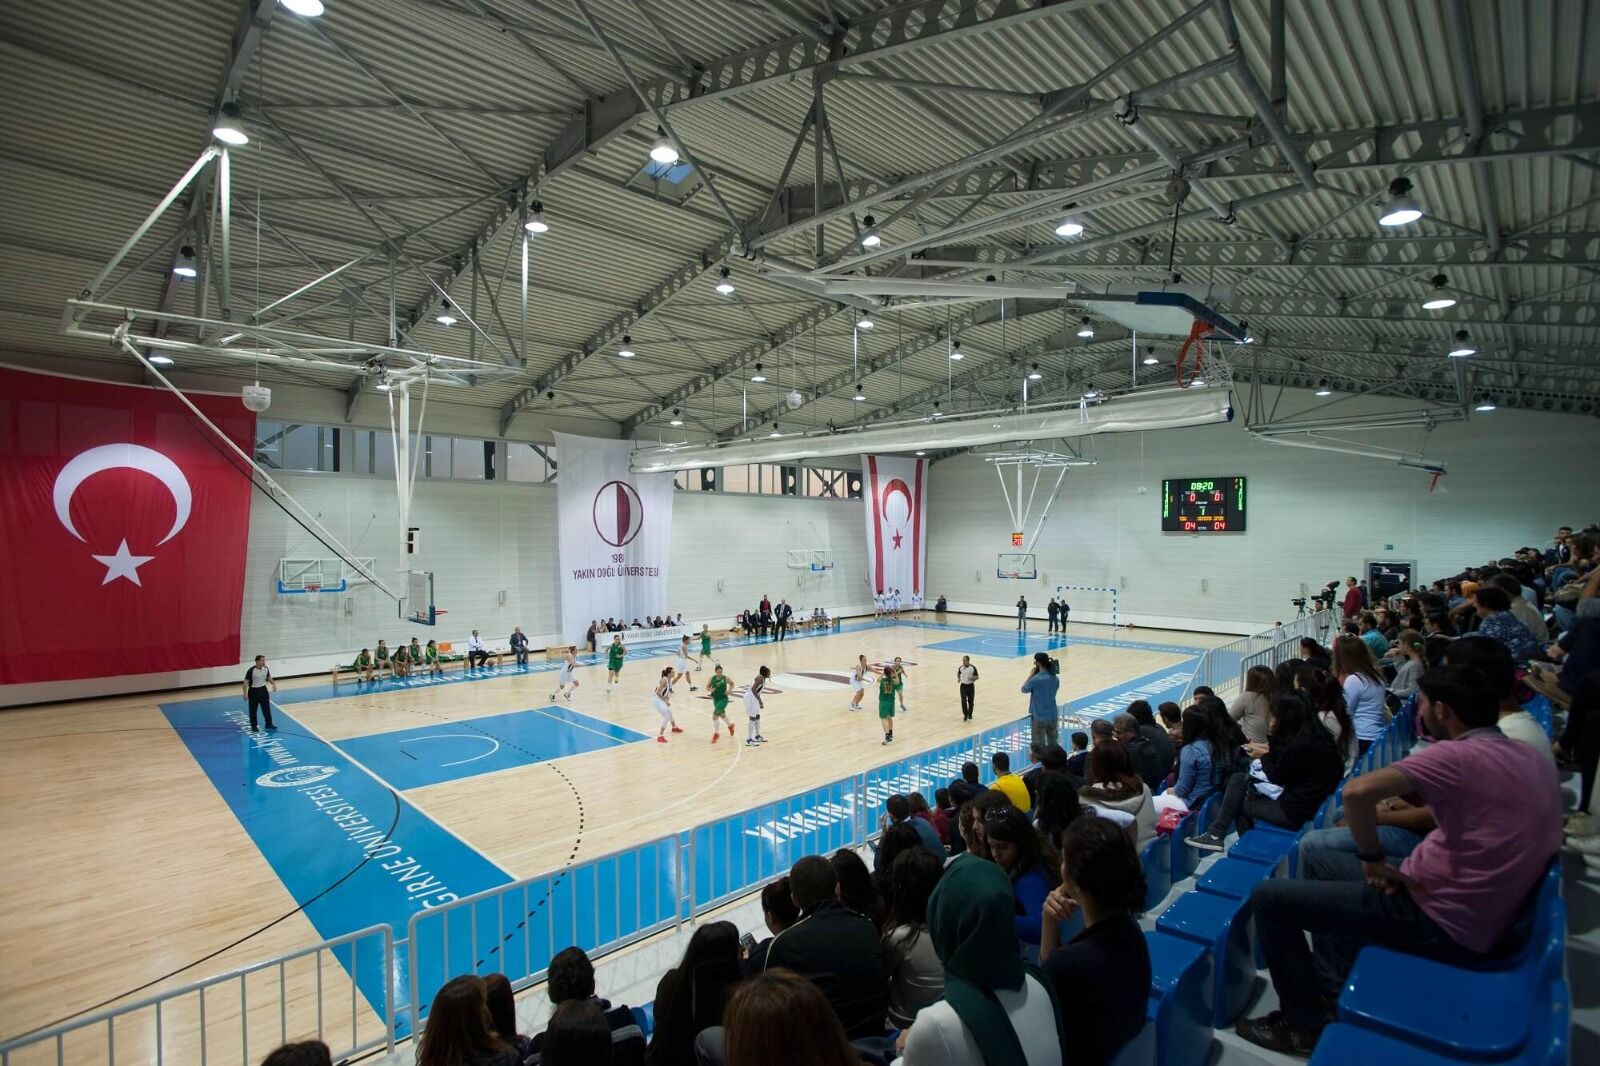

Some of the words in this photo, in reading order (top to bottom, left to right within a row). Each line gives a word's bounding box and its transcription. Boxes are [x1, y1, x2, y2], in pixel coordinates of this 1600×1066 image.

[1190, 494, 1196, 502] 0
[1214, 493, 1220, 502] 0
[573, 568, 596, 580] YAKIN
[297, 785, 403, 860] ÜNİVERSİTESİ
[743, 801, 852, 844] YAKIN
[382, 856, 461, 910] GİRNE
